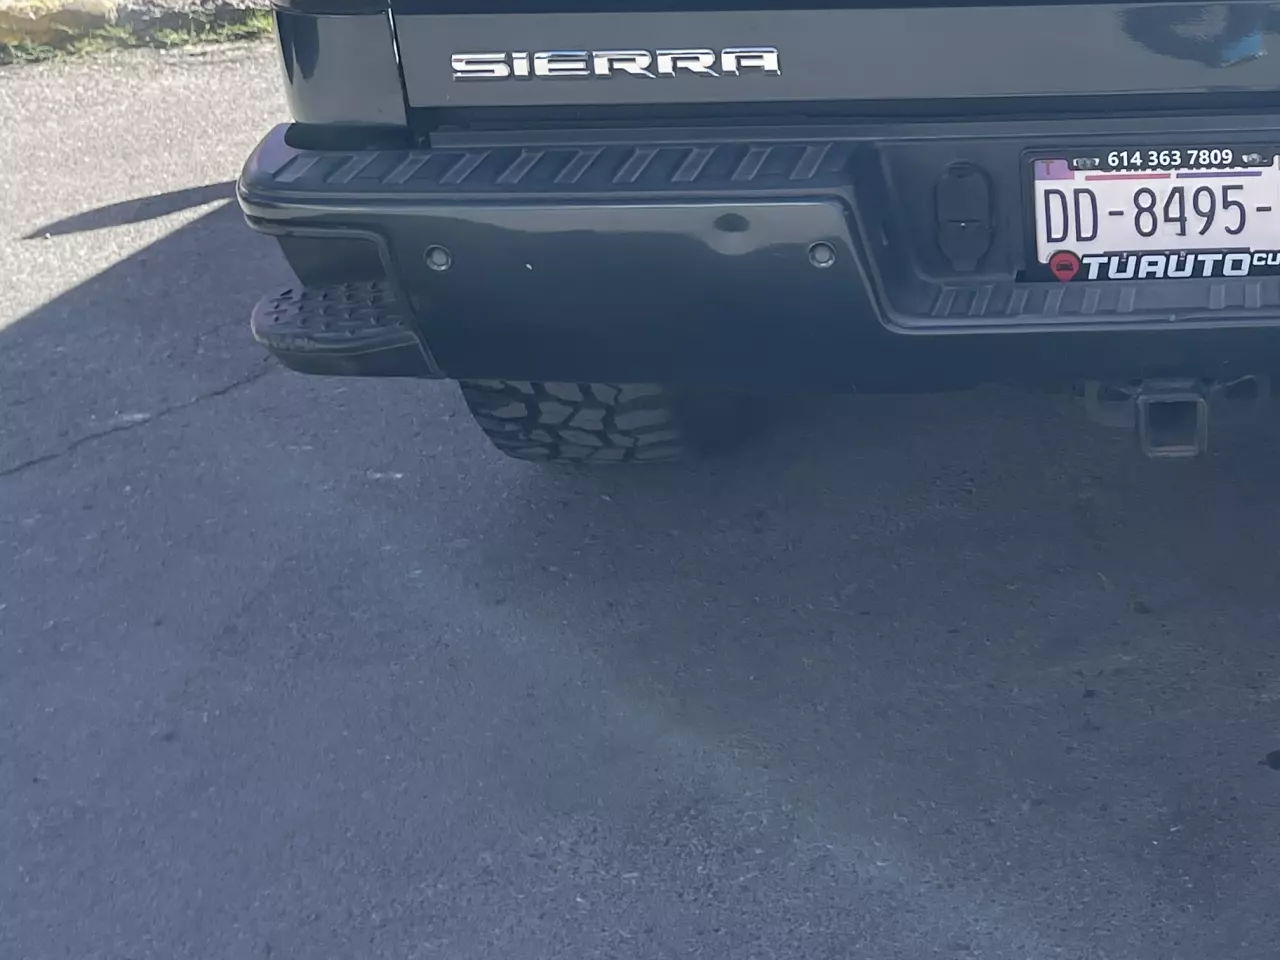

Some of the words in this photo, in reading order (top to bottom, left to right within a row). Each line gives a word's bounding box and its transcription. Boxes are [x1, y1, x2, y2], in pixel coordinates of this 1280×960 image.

[451, 46, 782, 81] SIERRA
[1108, 151, 1142, 167] 614
[1148, 150, 1182, 166] 363
[1187, 149, 1234, 165] 7809
